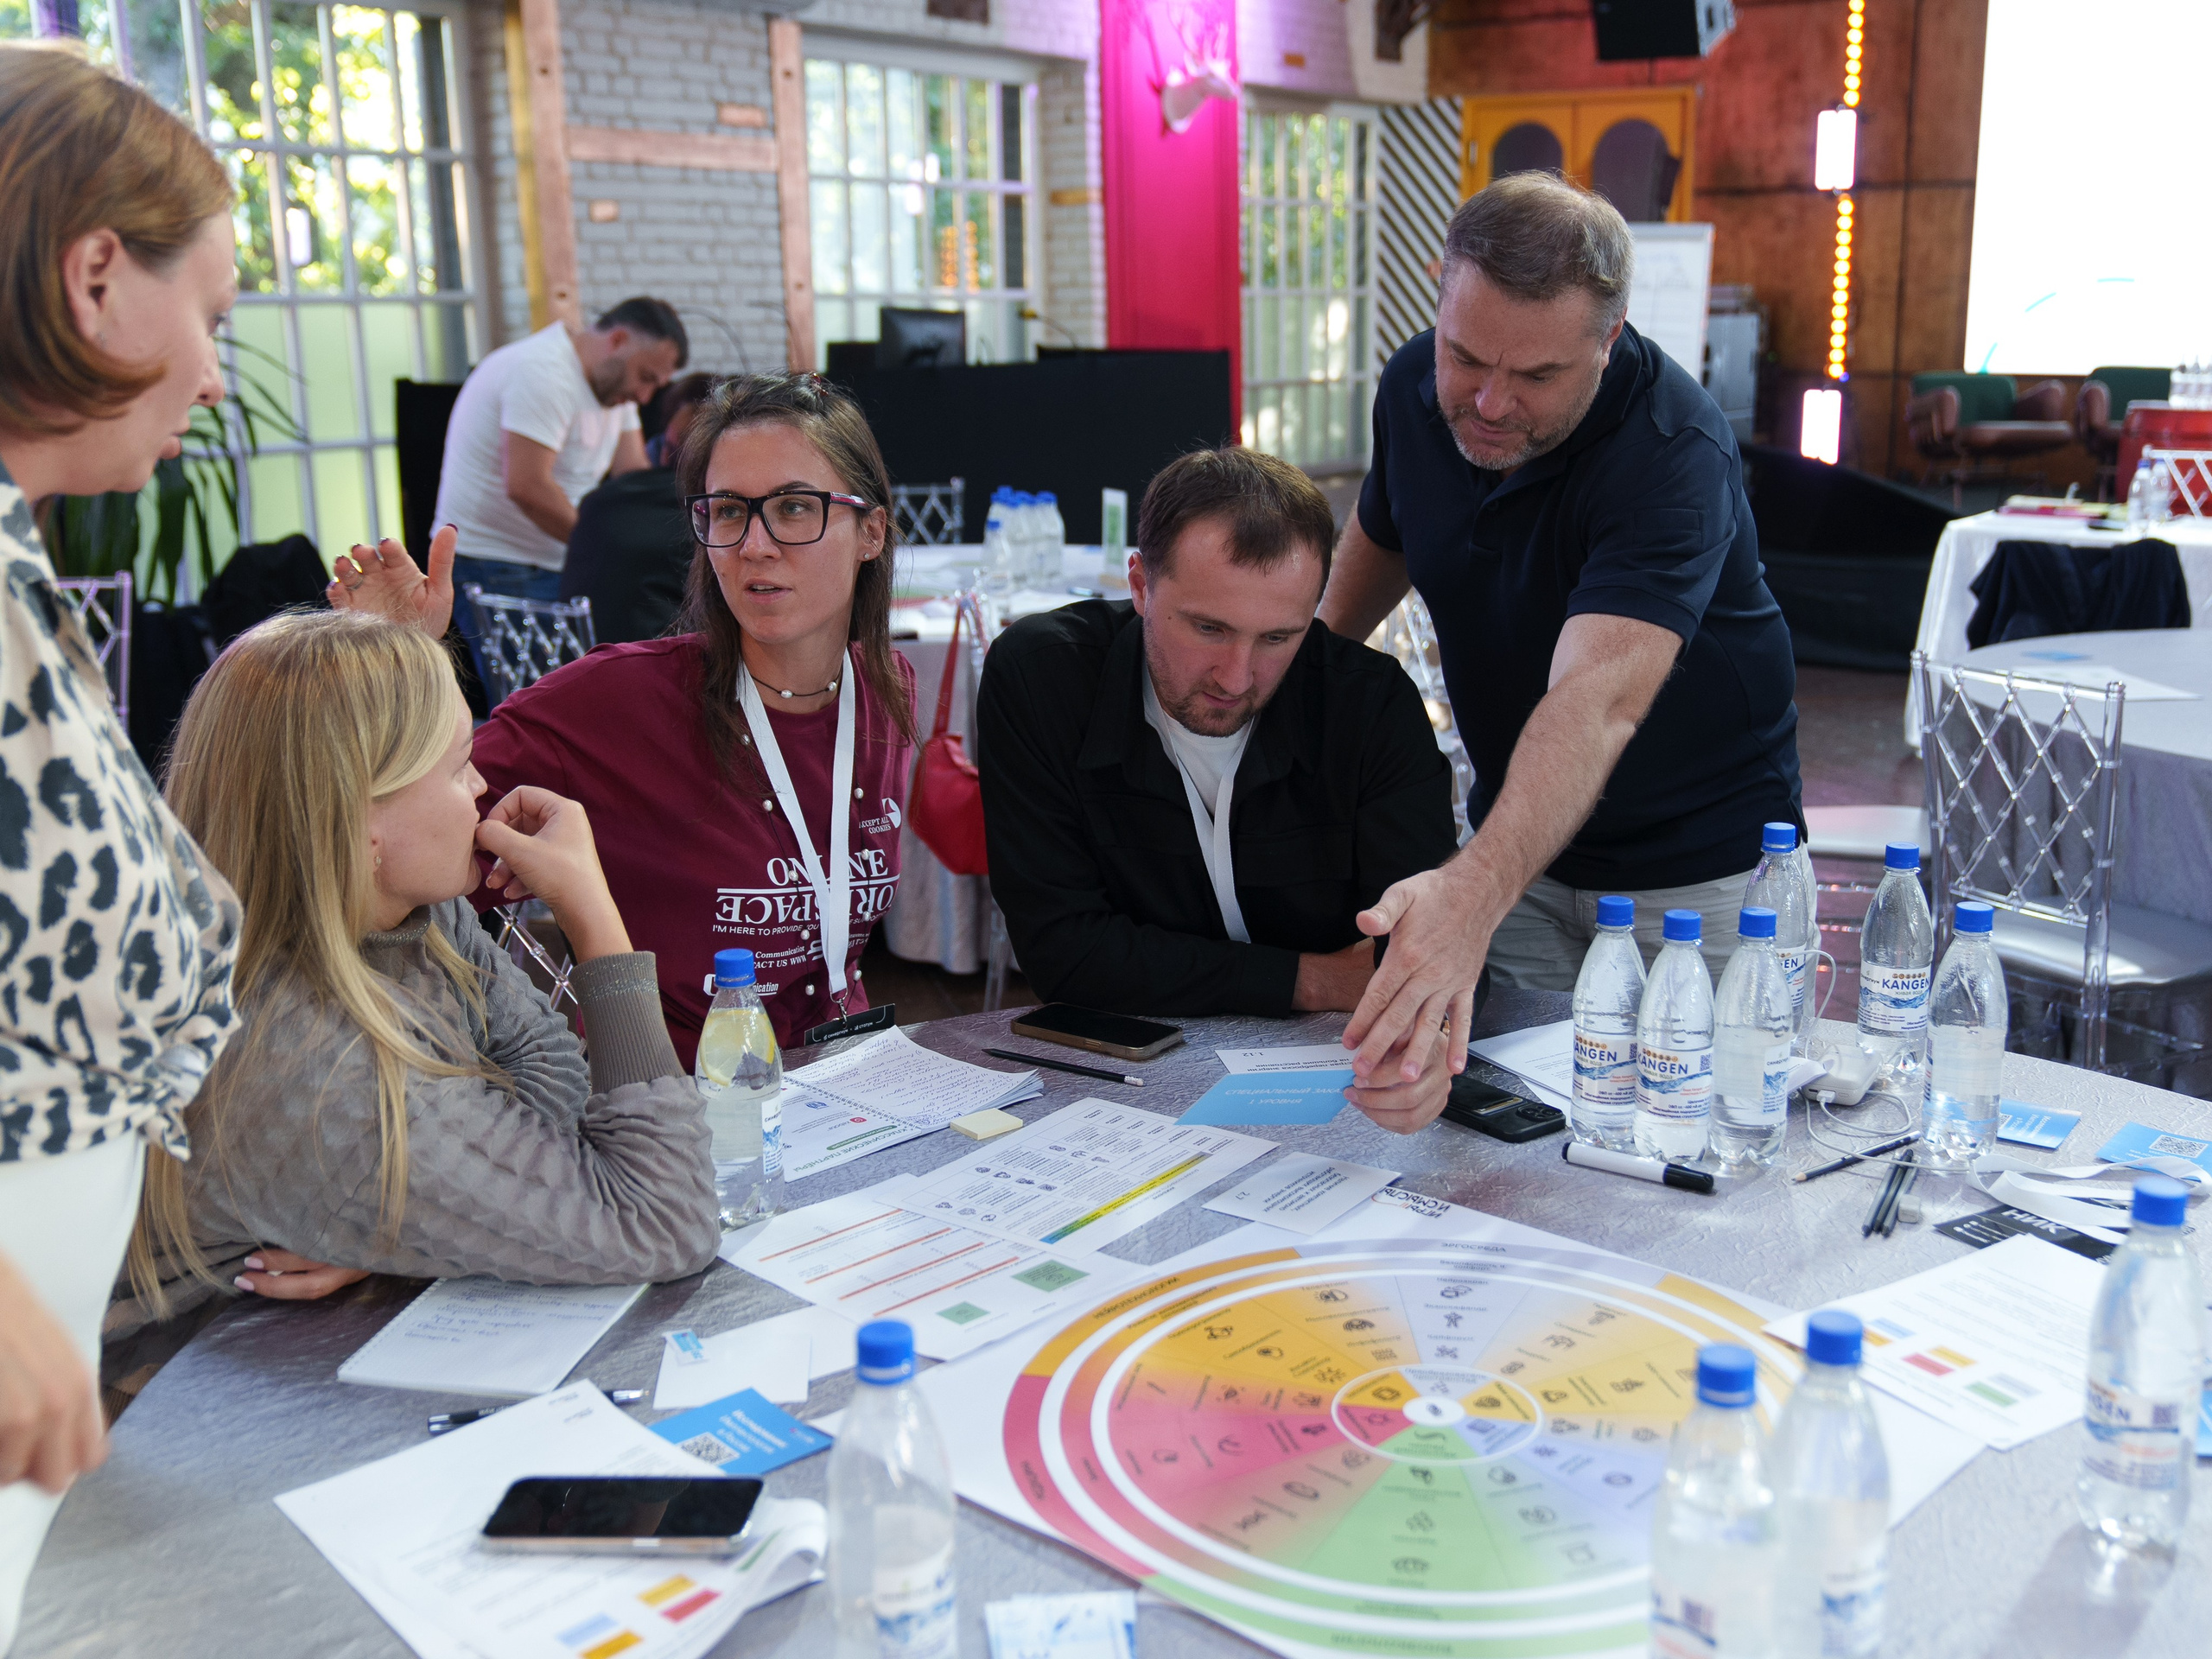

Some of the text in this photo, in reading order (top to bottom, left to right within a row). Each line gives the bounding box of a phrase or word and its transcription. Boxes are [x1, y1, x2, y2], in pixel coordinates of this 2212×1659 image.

[868, 823, 891, 834] COOKIES
[766, 849, 888, 887] ONNE
[729, 926, 755, 935] HERE
[772, 925, 803, 935] PROVIDE
[755, 945, 805, 959] Communication
[1882, 978, 1929, 990] KANGEN
[1573, 1044, 1618, 1063] ANGEN
[1637, 1052, 1688, 1075] KANGEN
[1225, 1087, 1312, 1096] СПЕЦИАЛЬНЫЙ
[839, 1128, 908, 1154] КЛАССИЧЕСКИЕ
[792, 1150, 840, 1173] ПАРТНЁРЫ
[1379, 1186, 1452, 1213] И СМЫСЛЫ
[1407, 1204, 1443, 1220] ИГРЫ
[1441, 1242, 1507, 1252] ЭРГОСРЕДА
